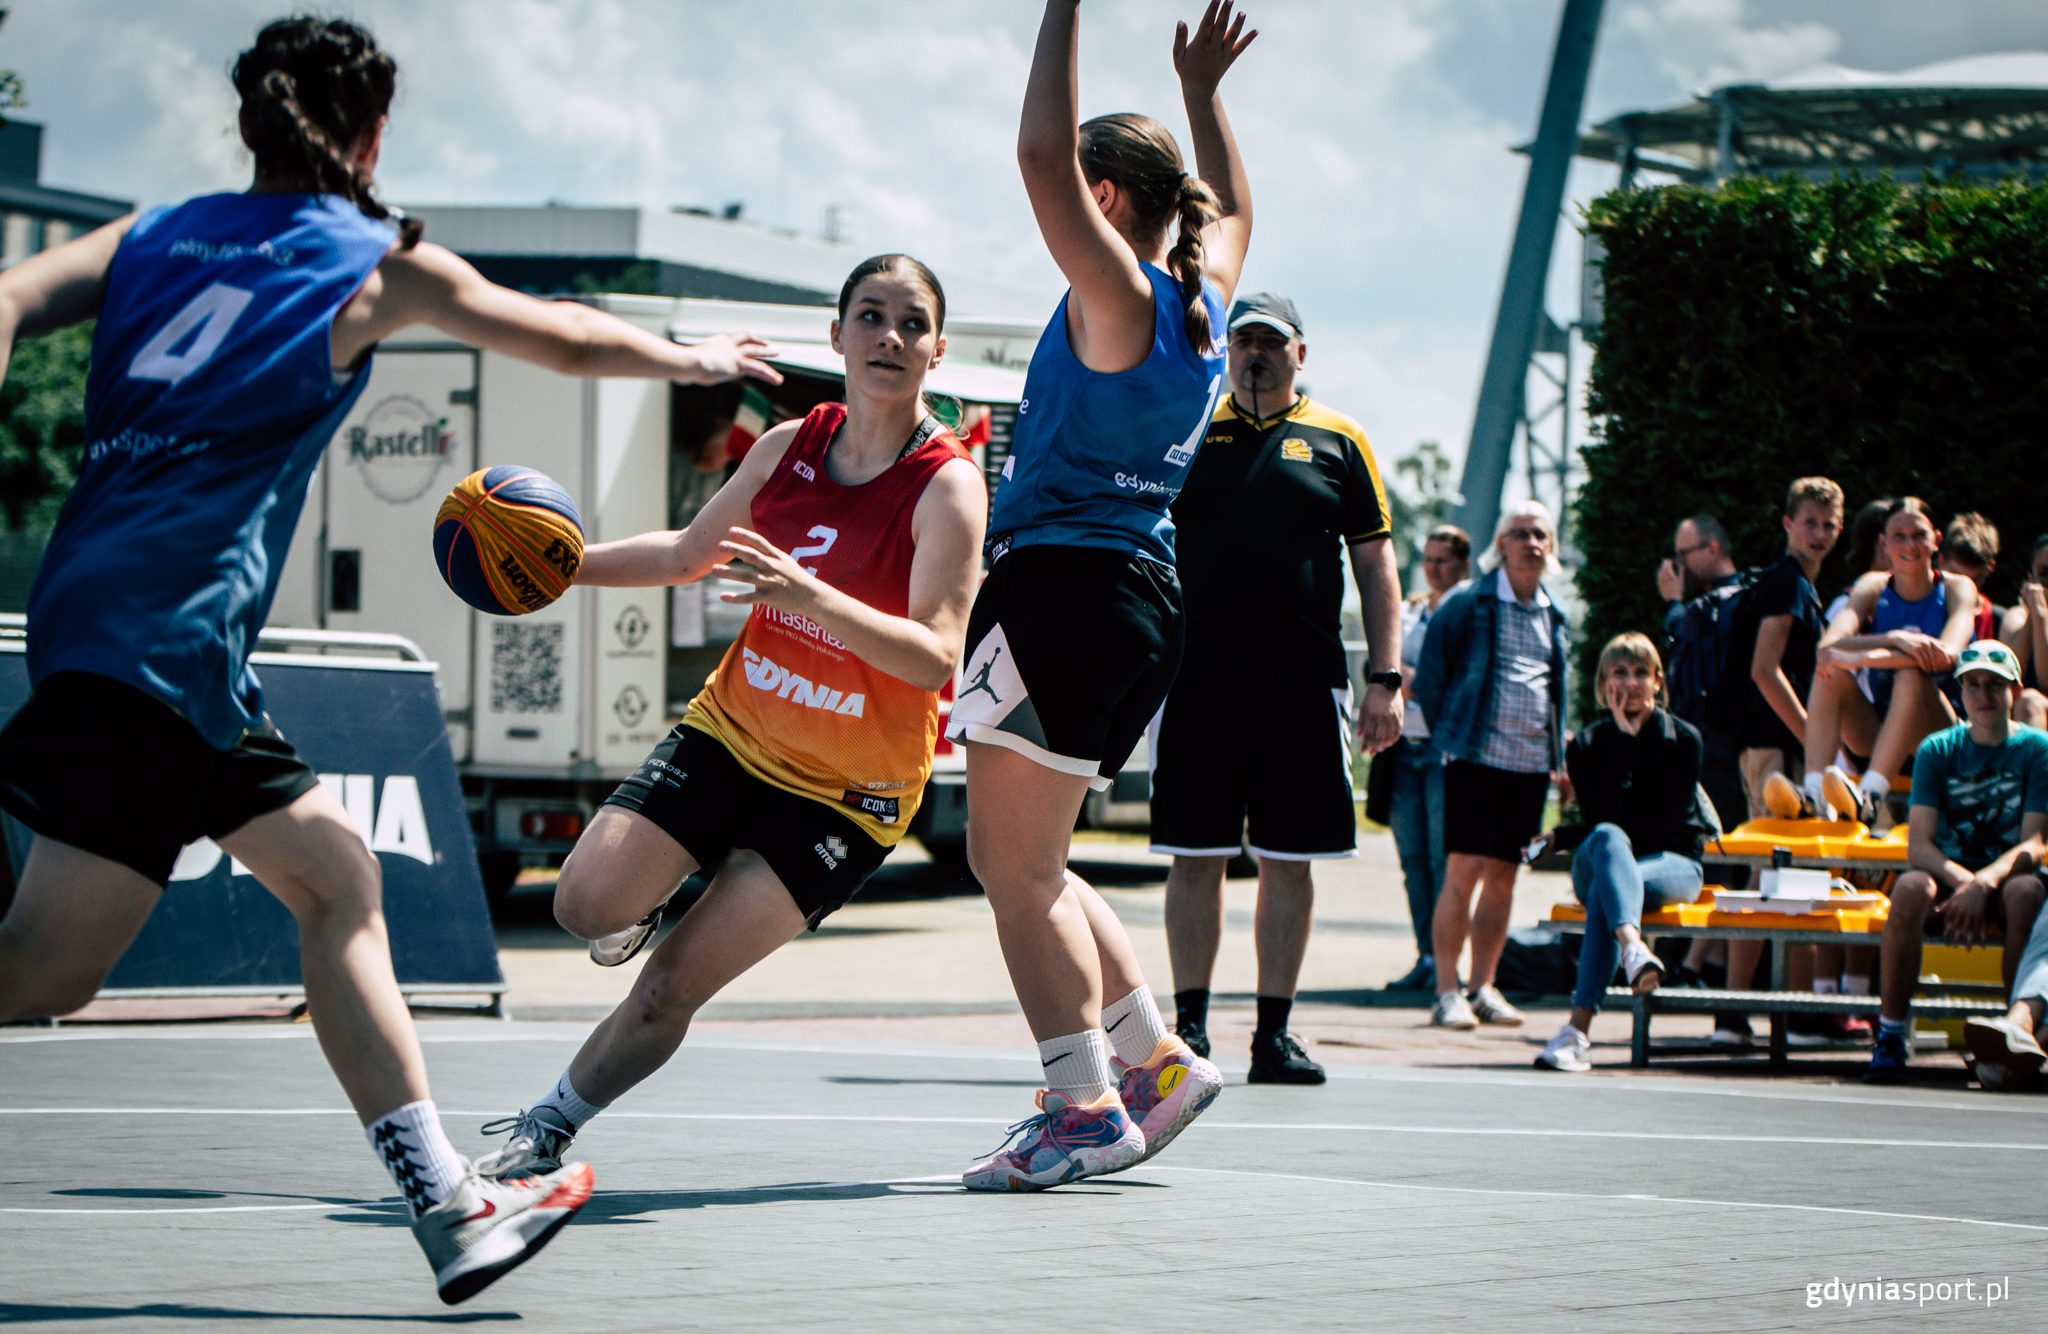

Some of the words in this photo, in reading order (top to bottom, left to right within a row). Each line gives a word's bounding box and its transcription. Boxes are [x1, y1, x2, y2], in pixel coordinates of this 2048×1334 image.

[128, 281, 254, 388] 4
[789, 524, 838, 577] 2
[765, 604, 850, 651] mastertea
[742, 646, 866, 719] GDYNIA
[647, 758, 689, 781] PZKOSZ
